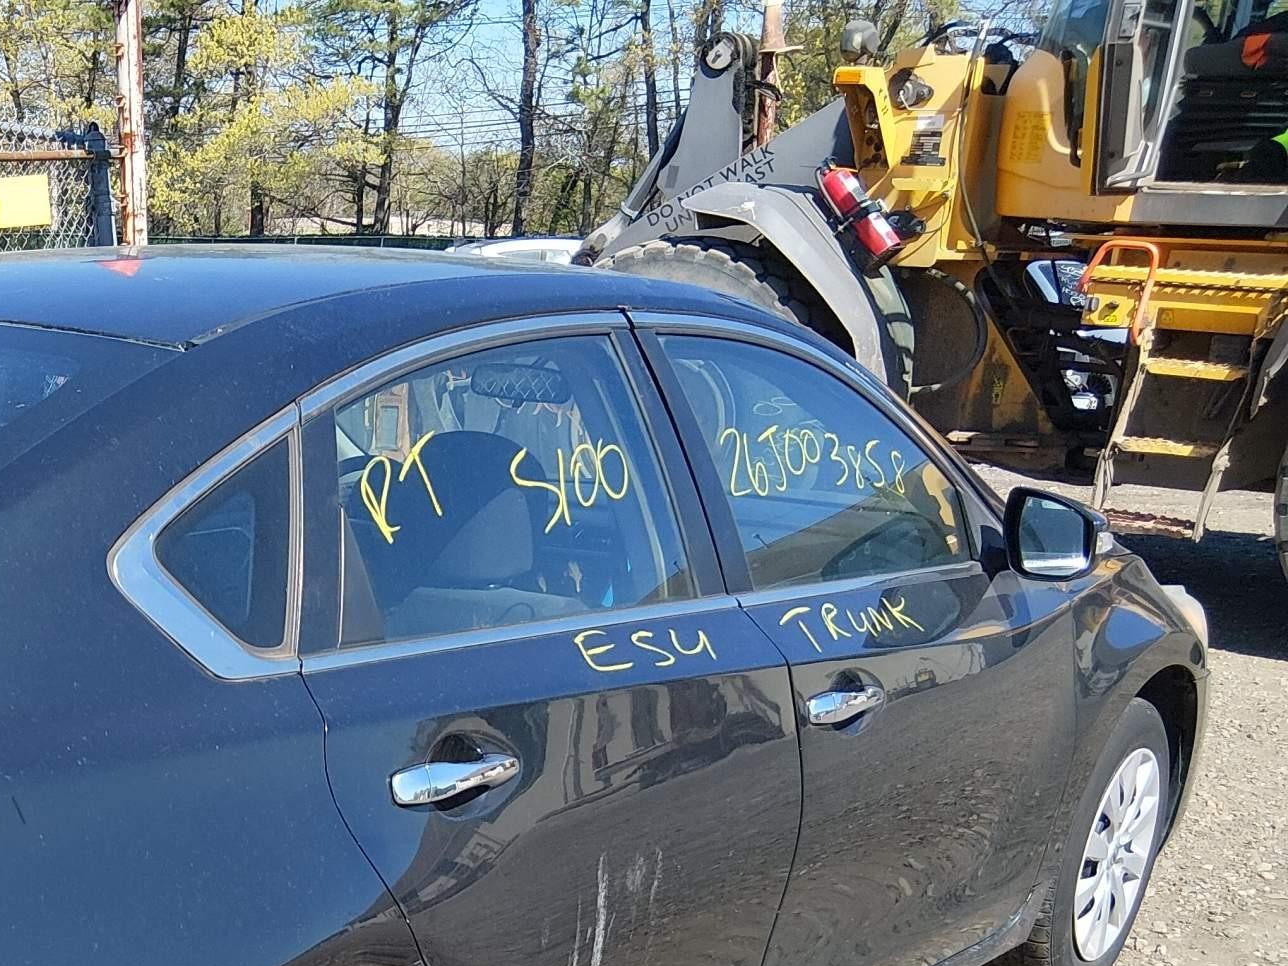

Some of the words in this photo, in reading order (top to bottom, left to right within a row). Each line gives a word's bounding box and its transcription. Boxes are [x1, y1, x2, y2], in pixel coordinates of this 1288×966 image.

[646, 203, 674, 227] DO
[719, 143, 775, 181] WALK
[736, 157, 775, 182] AST
[778, 596, 926, 653] TRUNK
